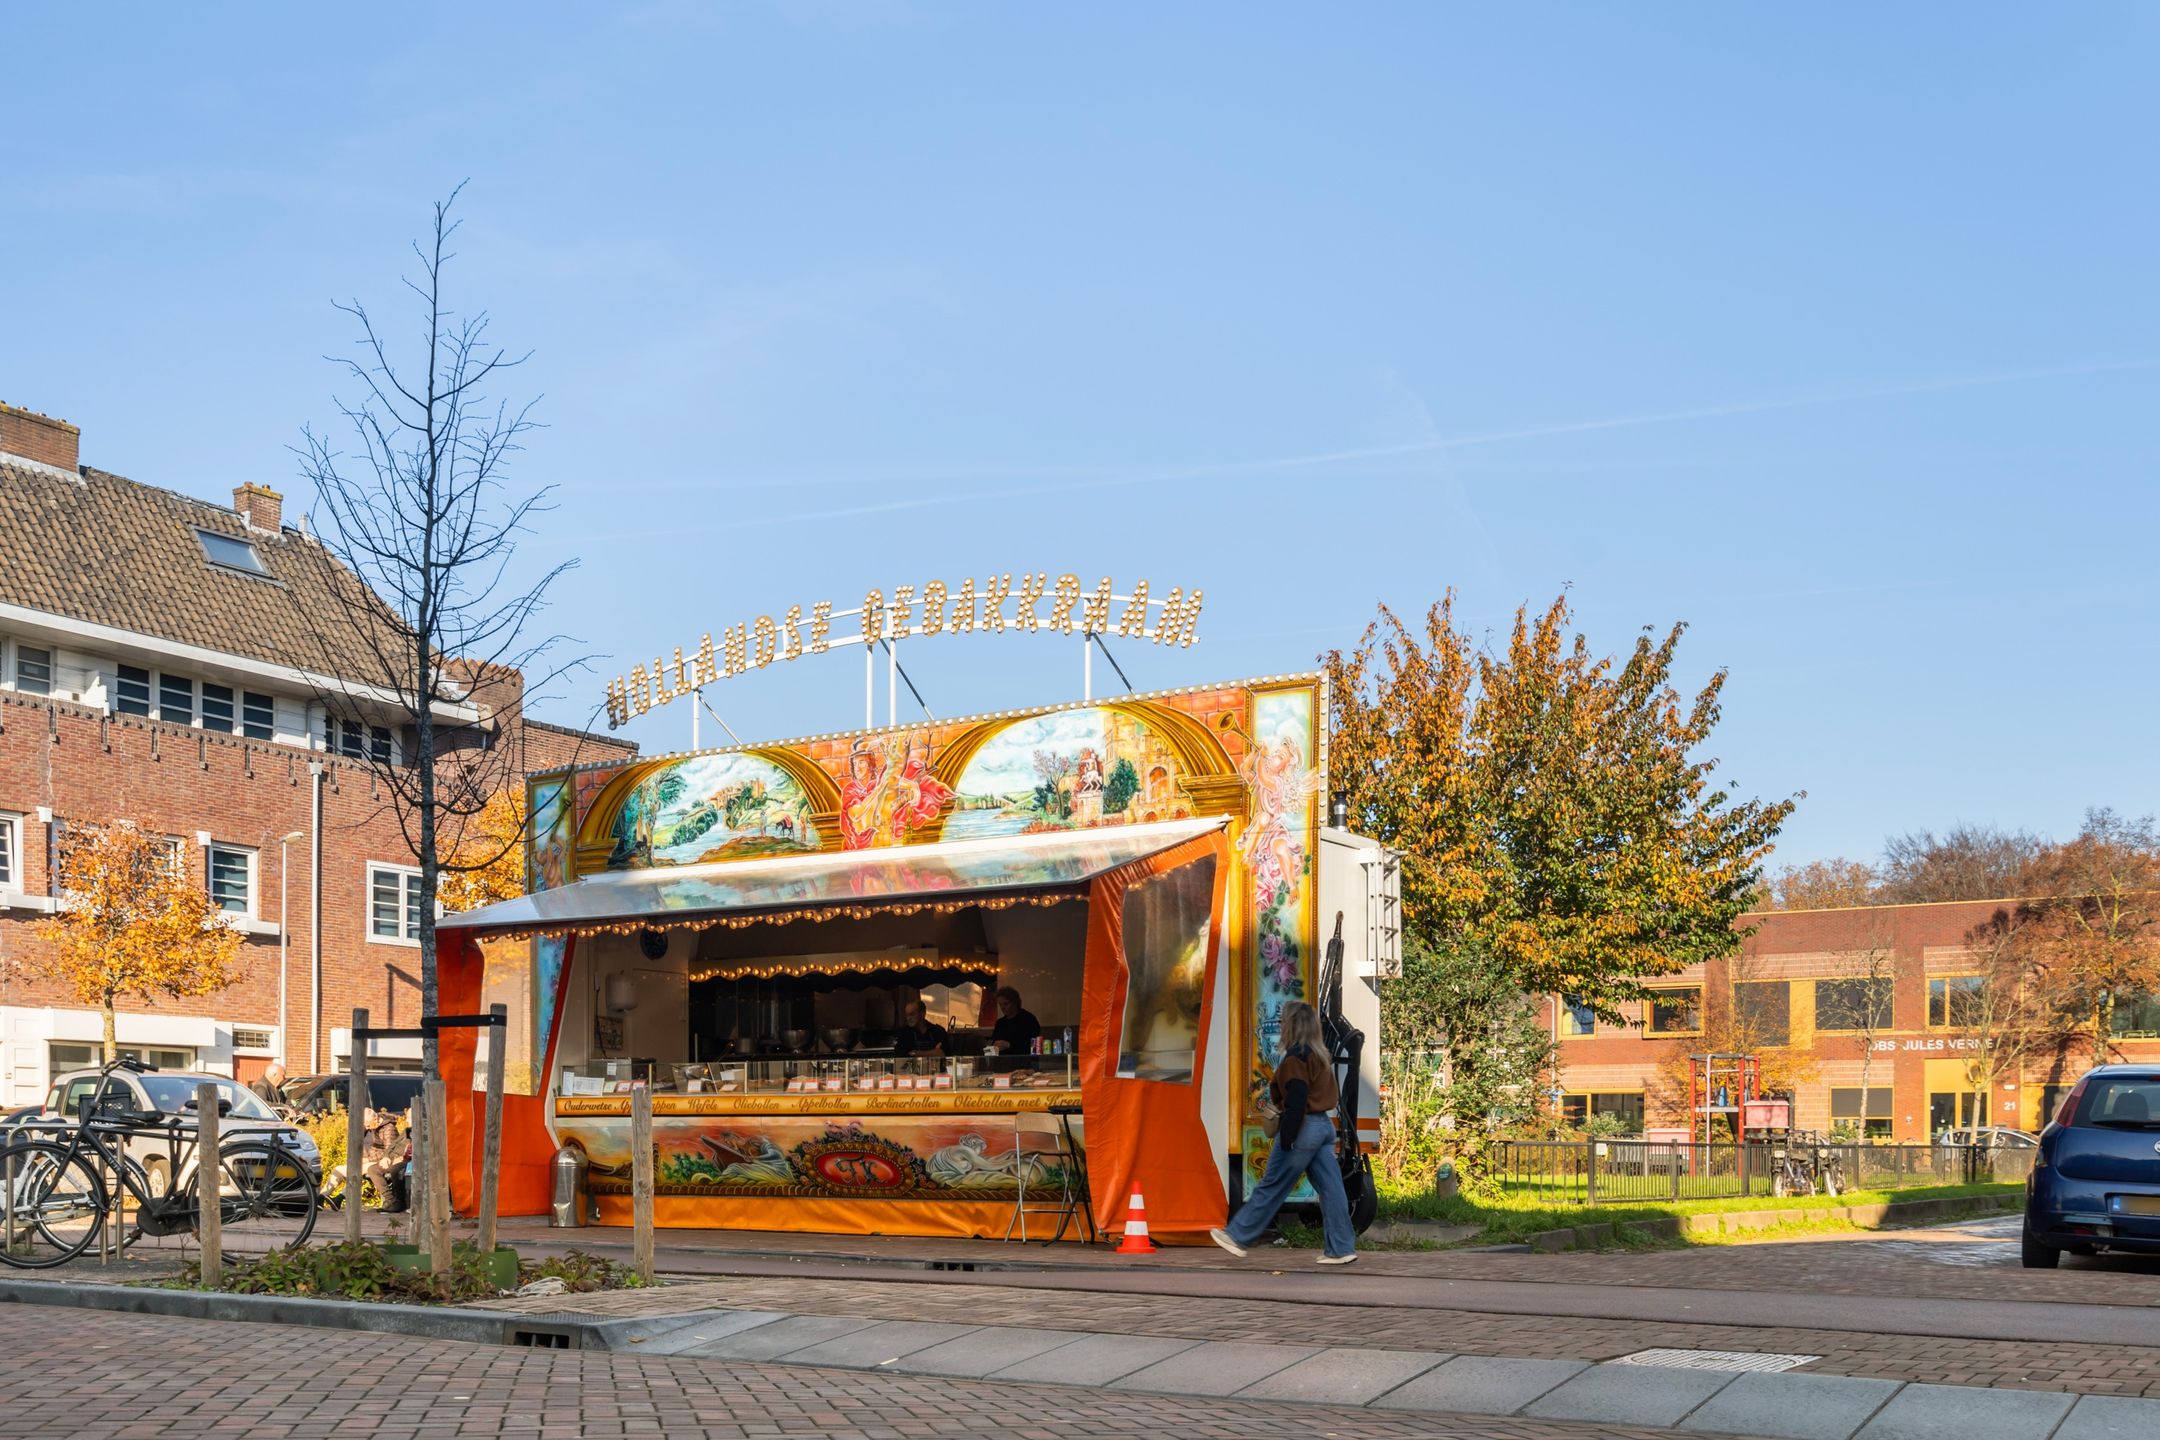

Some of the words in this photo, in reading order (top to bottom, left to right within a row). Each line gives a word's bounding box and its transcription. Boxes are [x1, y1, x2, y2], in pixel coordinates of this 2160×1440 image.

[607, 600, 832, 731] HOLLANDSE
[862, 572, 1203, 649] GEBAKKRAAM
[1903, 1040, 1944, 1051] JULES
[564, 1100, 612, 1111] Ouderwetse
[688, 1098, 717, 1113] Wafels
[733, 1097, 780, 1110] Oliebollen
[792, 1096, 850, 1112] Appelbollen
[866, 1096, 940, 1109] Berlinerbollen
[953, 1094, 1013, 1109] Oliebollen
[1017, 1097, 1041, 1107] met
[2003, 1102, 2016, 1111] 21
